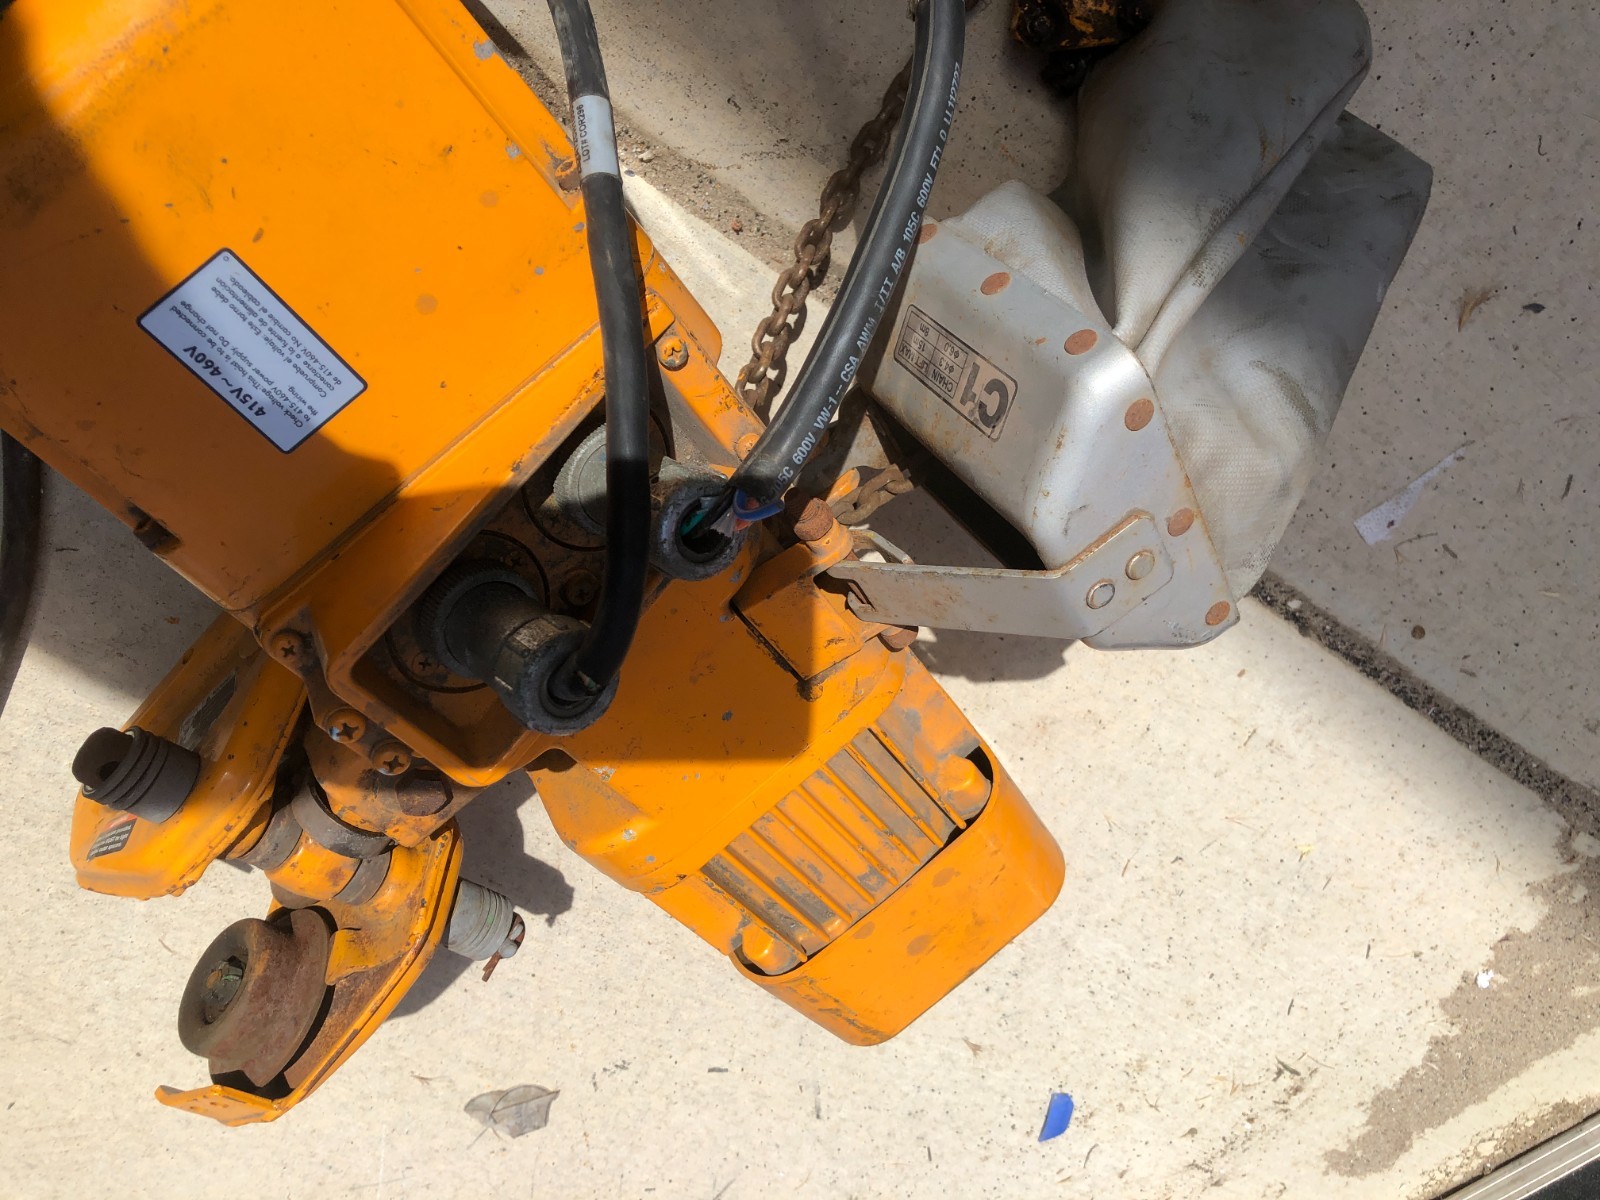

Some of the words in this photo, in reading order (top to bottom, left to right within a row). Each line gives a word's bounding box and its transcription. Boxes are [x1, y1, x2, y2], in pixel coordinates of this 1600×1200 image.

[580, 139, 591, 163] LOT#
[210, 286, 228, 303] debe
[792, 432, 816, 465] 600V
[813, 396, 838, 430] VW-1
[841, 355, 860, 383] CSA
[856, 316, 877, 352] AWM
[891, 247, 906, 275] A/B
[902, 211, 920, 243] 105C
[916, 172, 934, 208] 600V
[929, 145, 942, 170] FT1
[169, 305, 206, 337] connected
[180, 300, 206, 324] change
[228, 303, 247, 322] torno
[205, 324, 218, 335] not
[247, 321, 261, 335] Este
[267, 313, 291, 336] cambie
[918, 321, 931, 338] 8m
[218, 335, 230, 347] Do
[267, 326, 288, 348] fuente
[230, 360, 247, 377] hoist
[251, 367, 274, 385] power
[302, 360, 334, 390] conectarse
[292, 363, 326, 397] Compruebe
[930, 368, 954, 394] CHAIN
[270, 386, 302, 413] 415-460V
[959, 361, 1010, 429] C1
[283, 408, 303, 427] Check
[307, 404, 318, 415] the
